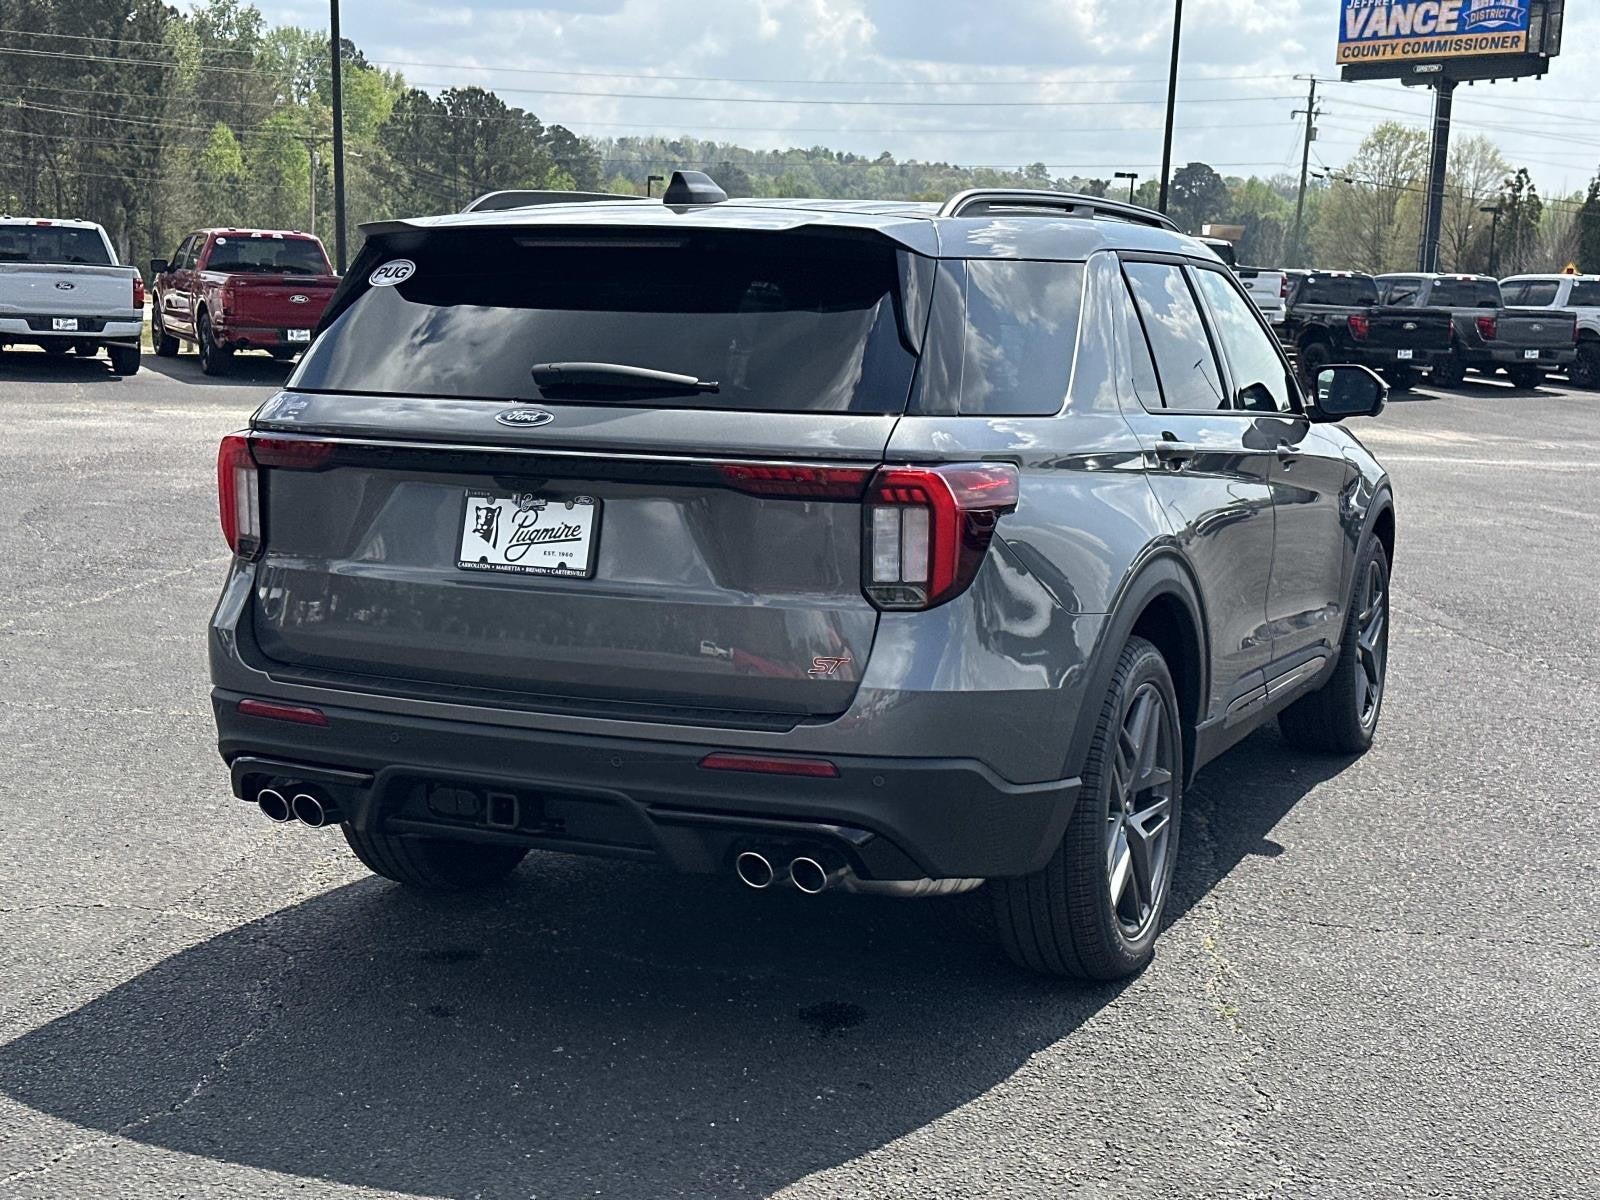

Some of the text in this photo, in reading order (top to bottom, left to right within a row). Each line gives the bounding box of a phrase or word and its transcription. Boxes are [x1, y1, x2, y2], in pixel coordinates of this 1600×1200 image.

[1345, 1, 1462, 39] VANCE
[1470, 8, 1519, 23] DISTRICT 4
[1342, 35, 1521, 59] COUNTY COMMISSIONER
[374, 266, 410, 279] PUG
[504, 508, 582, 562] Pugmire
[457, 561, 586, 577] CARROLLTON MARIETTA BREMEN CARTERSVILLE
[808, 656, 851, 675] ST
